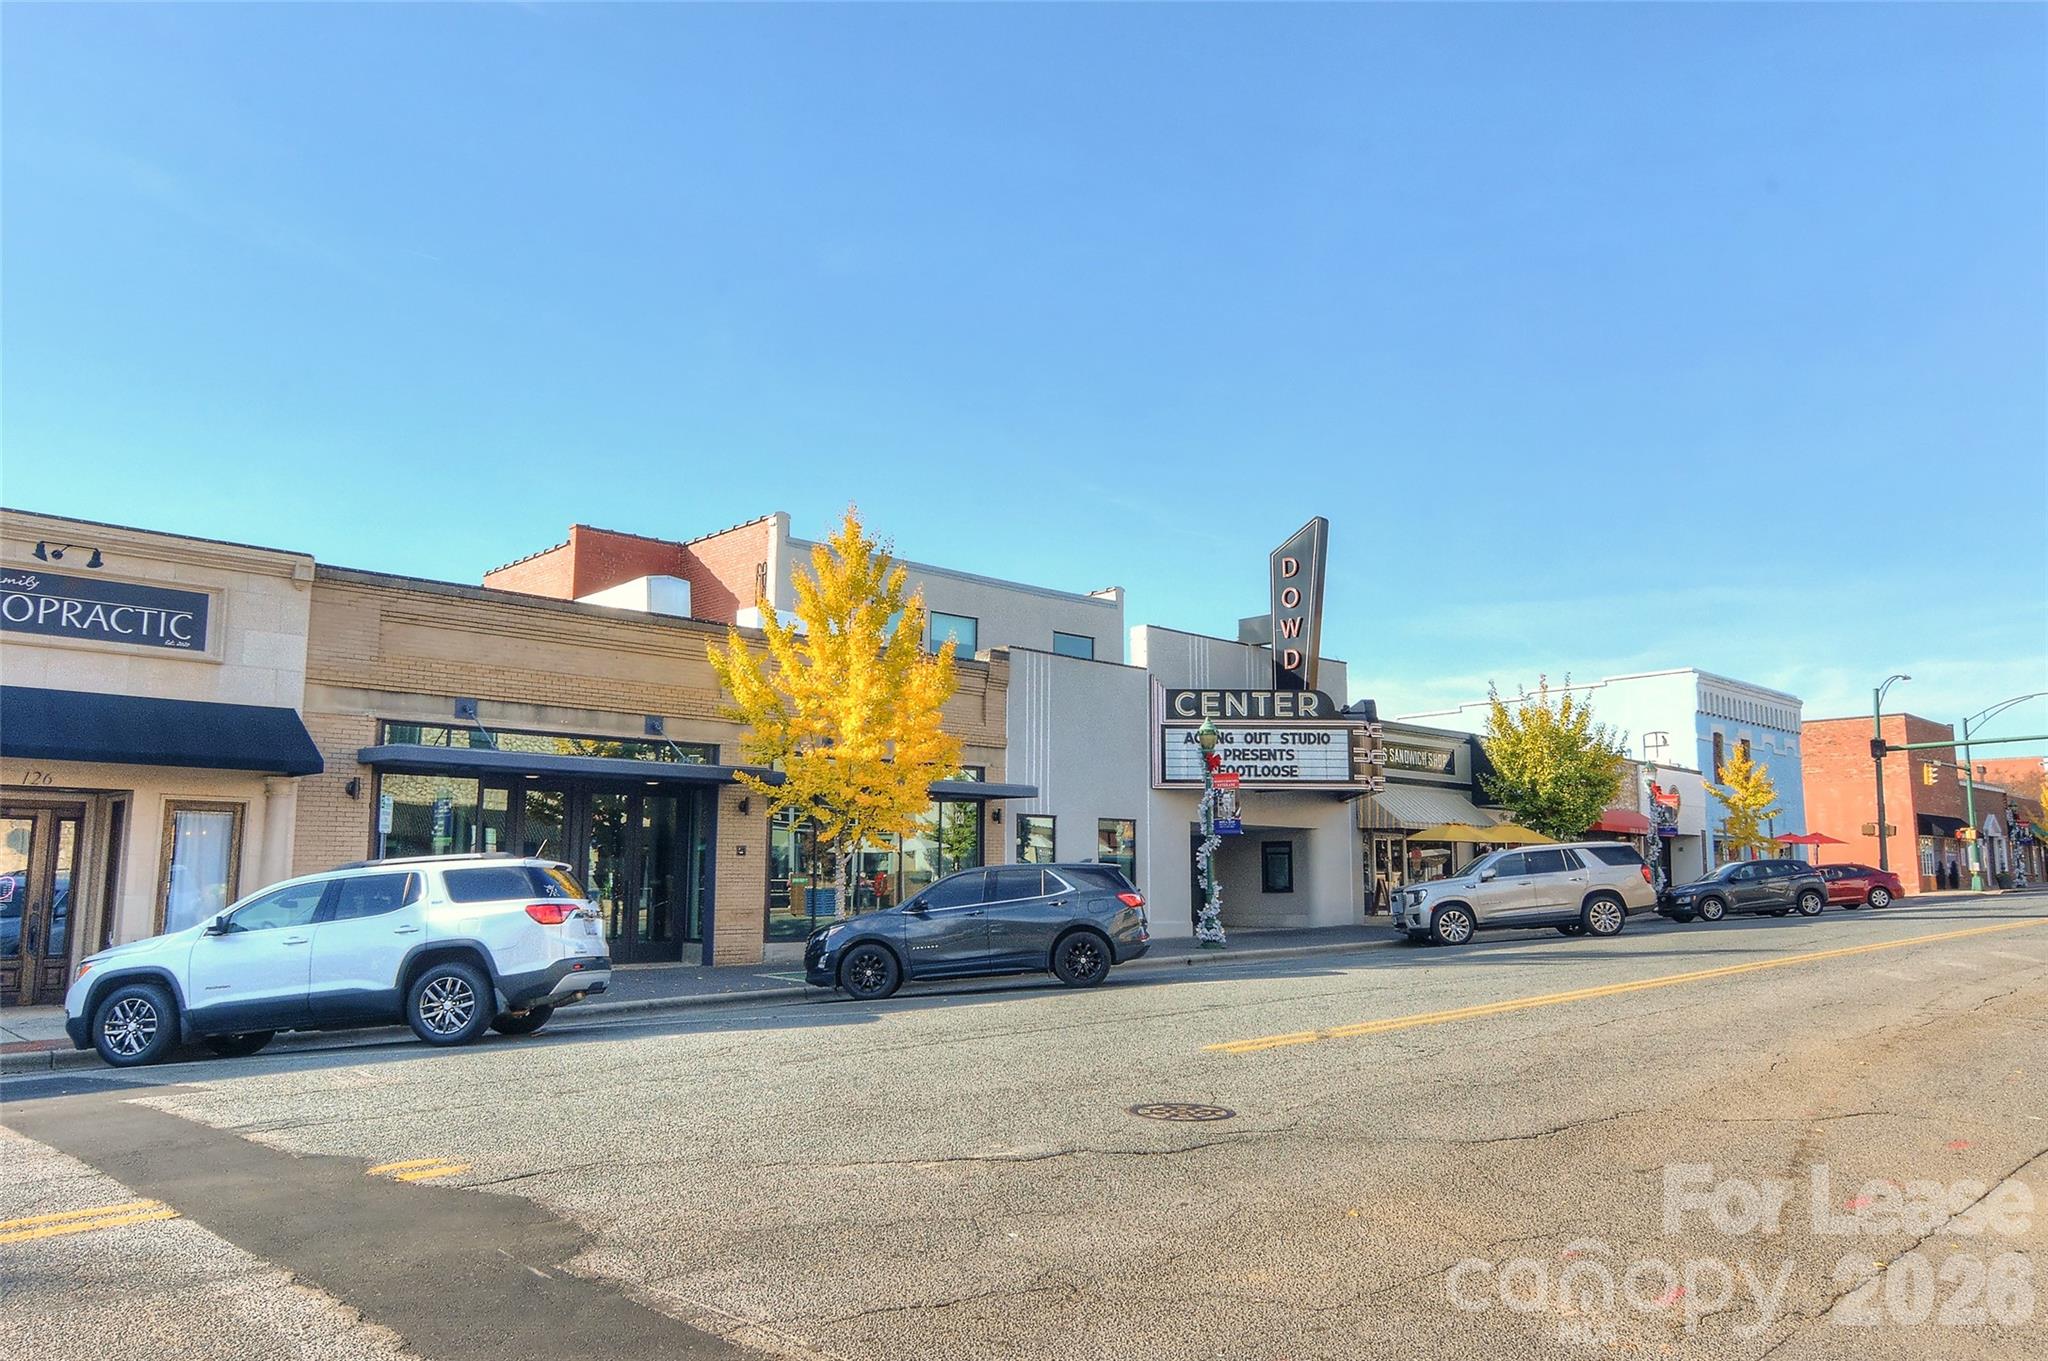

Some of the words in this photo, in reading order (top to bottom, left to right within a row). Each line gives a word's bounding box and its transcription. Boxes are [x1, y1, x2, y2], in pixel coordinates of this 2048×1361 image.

[0, 575, 40, 590] mily
[2, 594, 193, 640] OPRACTIC
[1280, 556, 1303, 670] DOWD
[1174, 691, 1319, 717] CENTER
[1184, 732, 1234, 745] ACNG
[1244, 732, 1272, 745] OUT
[1280, 732, 1331, 745] STUDIO
[1223, 749, 1295, 762] PRESENTS
[1389, 748, 1428, 766] SANDWICH
[1428, 752, 1448, 769] SHOP
[22, 771, 53, 785] 126
[1218, 765, 1299, 778] FOOTLOOSE
